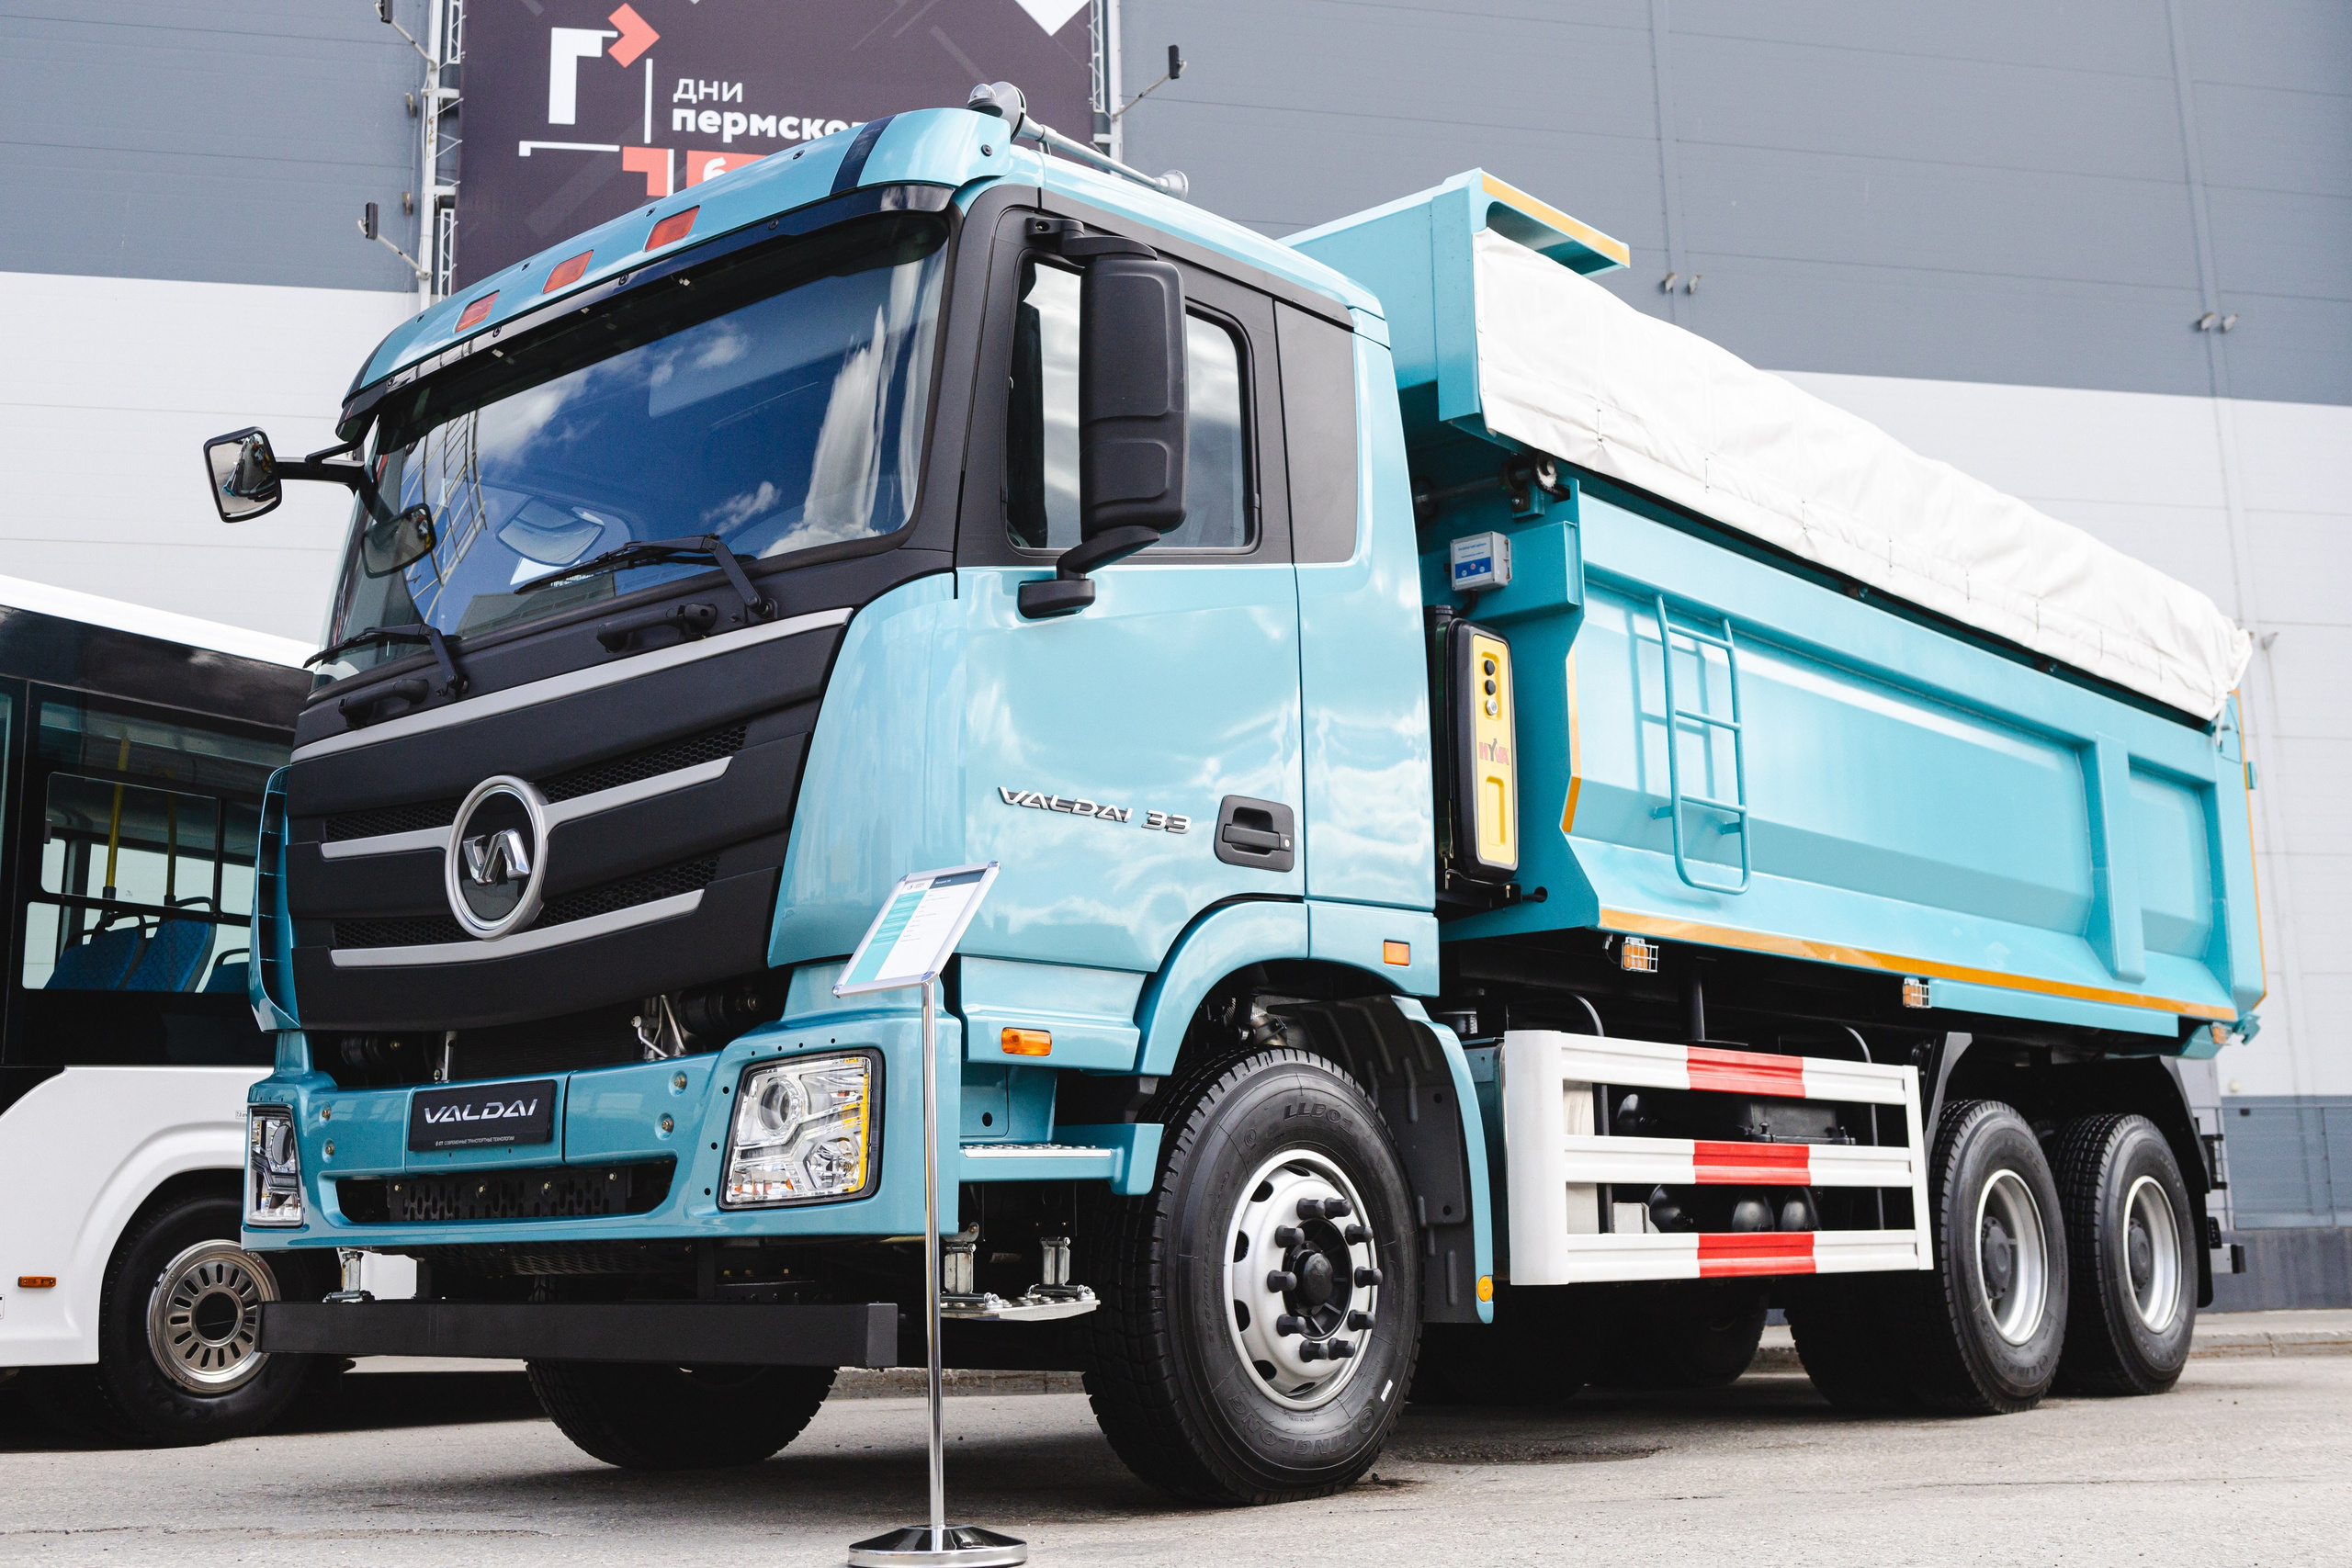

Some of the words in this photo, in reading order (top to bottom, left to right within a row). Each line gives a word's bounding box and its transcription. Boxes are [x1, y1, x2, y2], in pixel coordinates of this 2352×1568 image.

[673, 107, 869, 143] пермско
[1479, 738, 1510, 765] HYVA
[998, 786, 1133, 823] VALDAI
[1141, 809, 1192, 835] 33
[424, 1099, 538, 1123] VALDAI
[1229, 1394, 1352, 1457] LINGLONG
